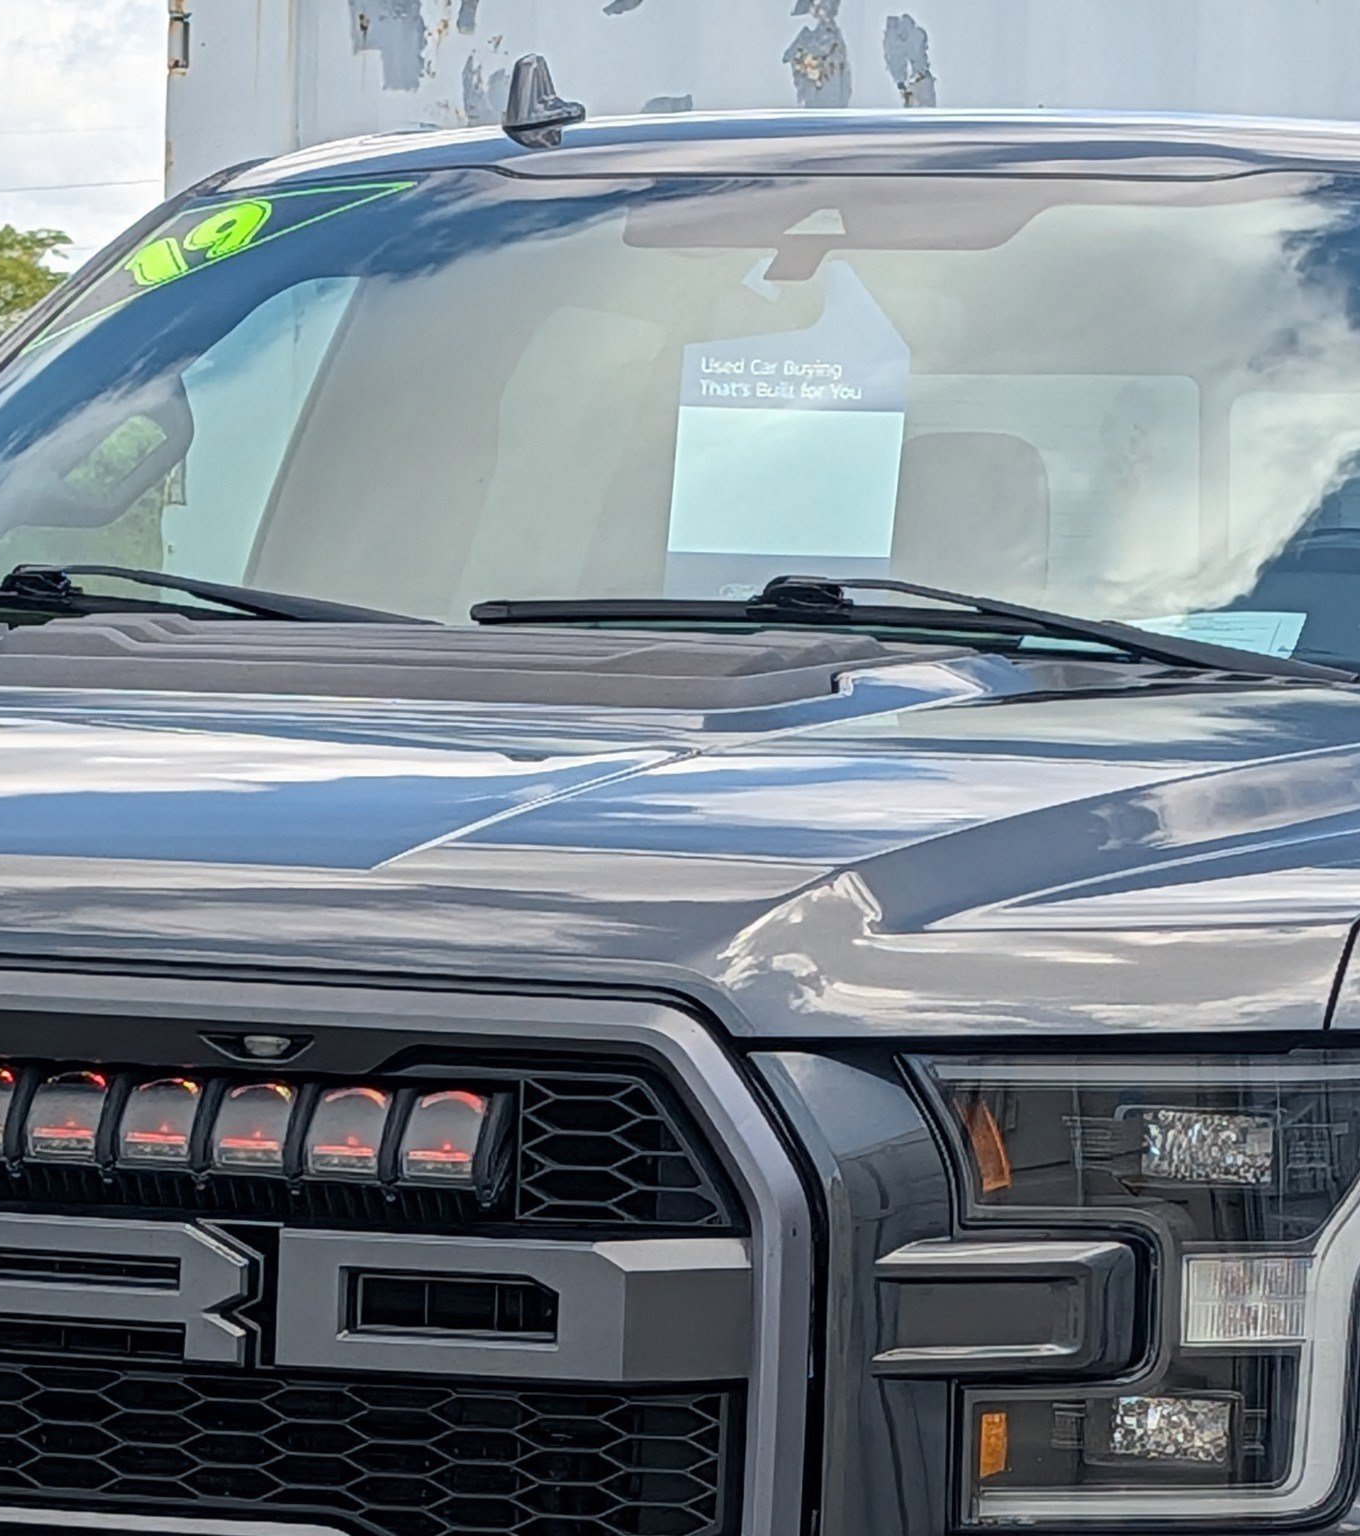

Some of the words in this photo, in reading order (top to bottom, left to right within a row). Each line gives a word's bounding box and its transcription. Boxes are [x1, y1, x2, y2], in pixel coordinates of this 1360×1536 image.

[125, 199, 273, 285] 19
[701, 357, 744, 374] Used
[750, 359, 778, 375] Car
[783, 359, 843, 380] Buying
[701, 379, 750, 397] That's
[800, 382, 826, 398] for
[830, 383, 862, 400] You
